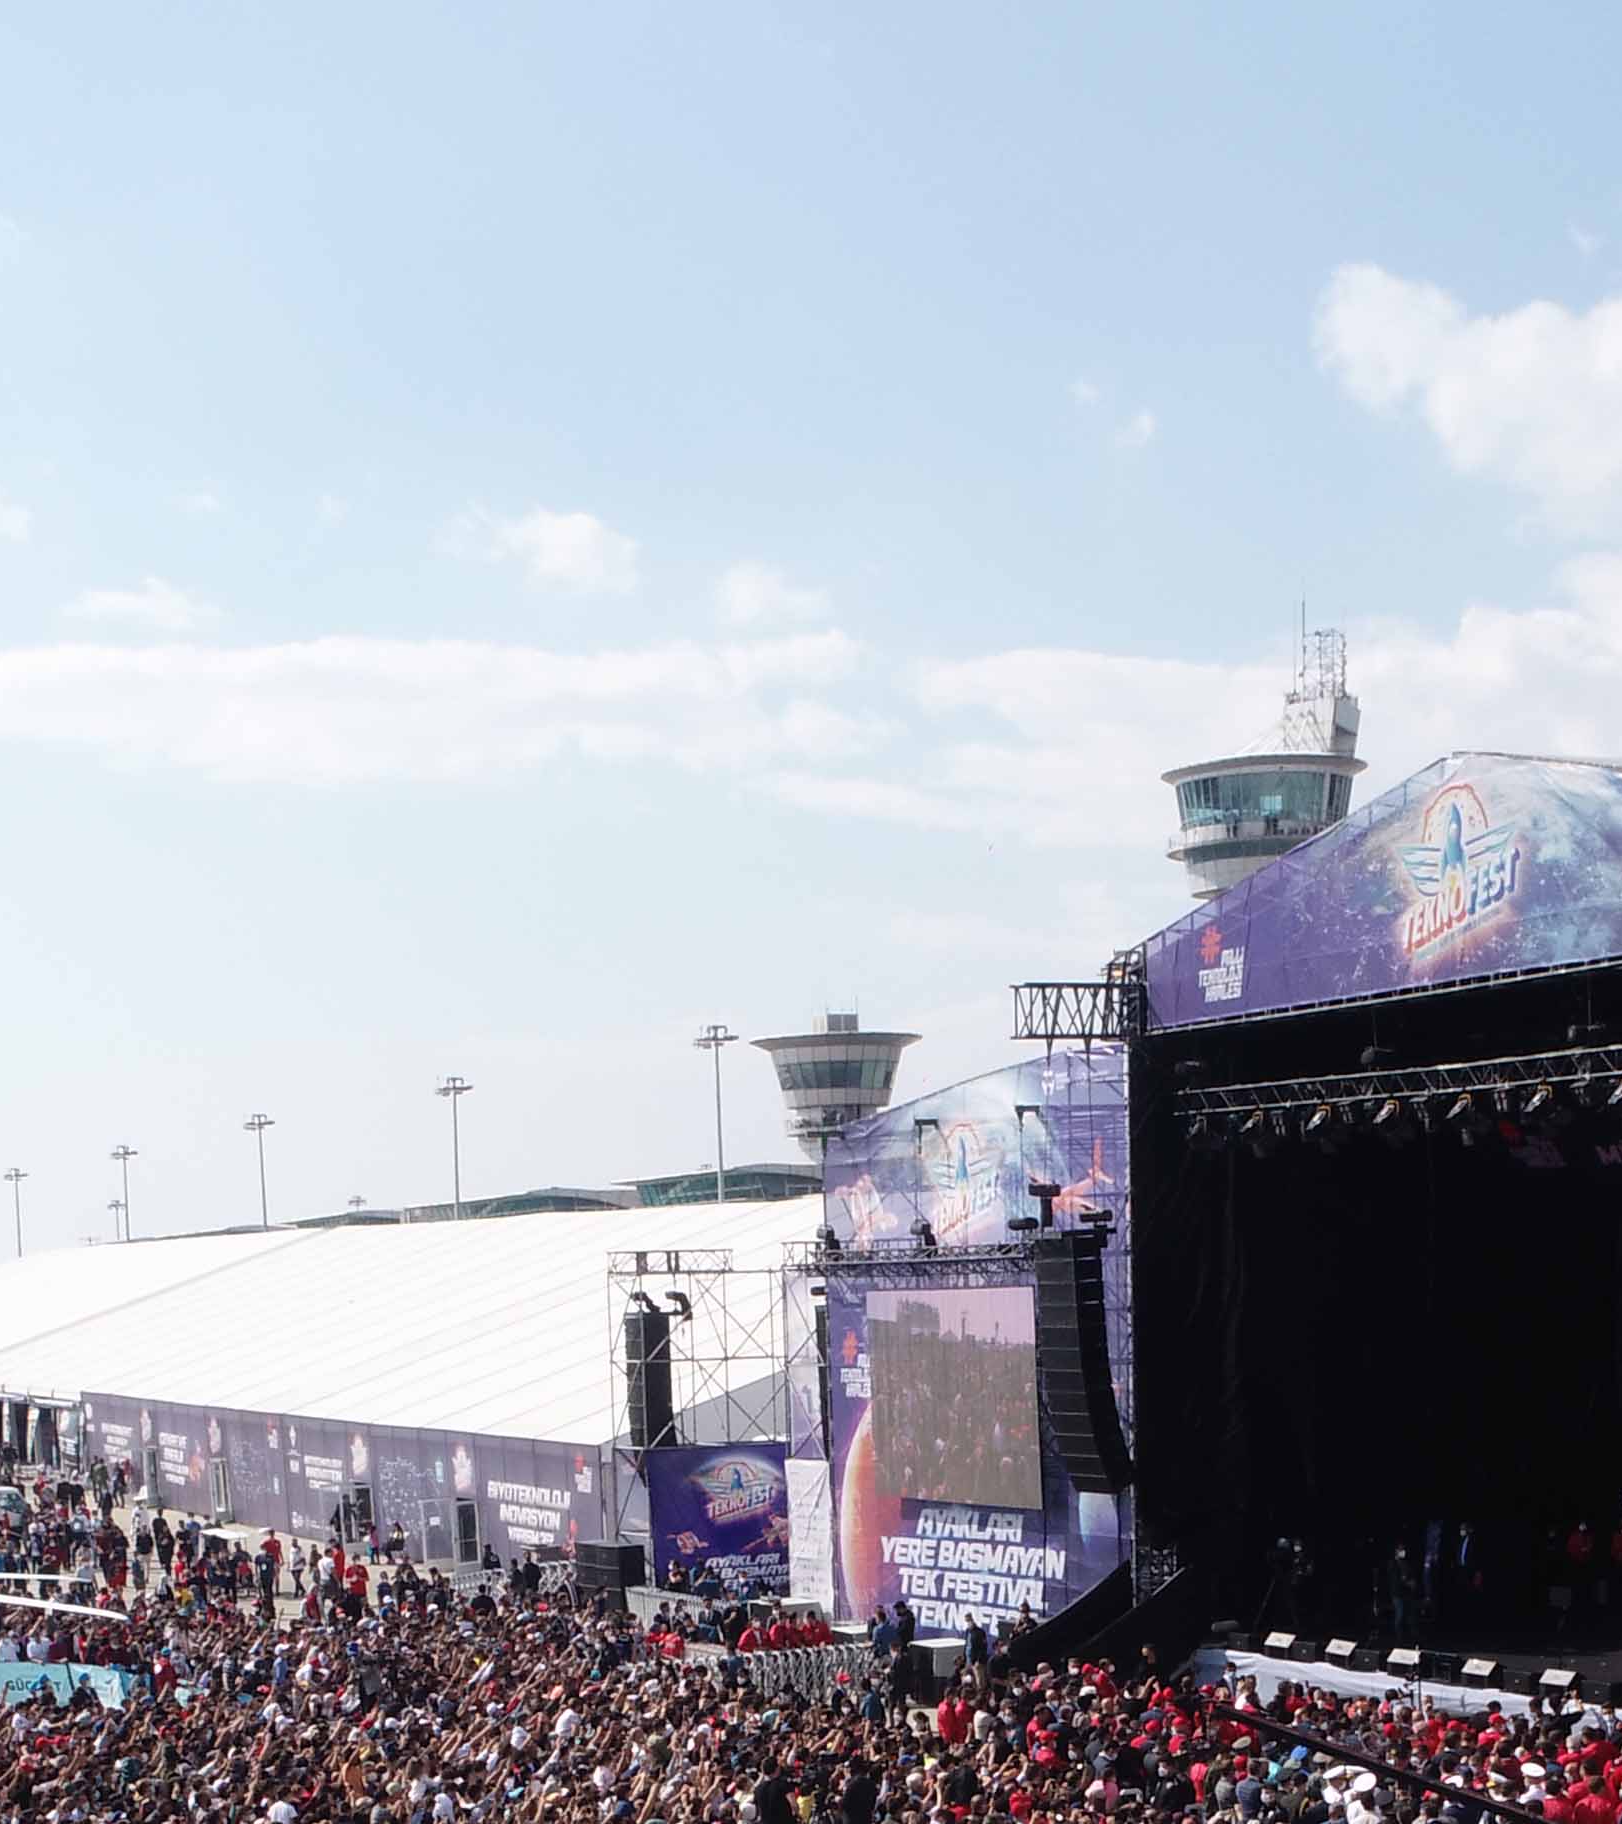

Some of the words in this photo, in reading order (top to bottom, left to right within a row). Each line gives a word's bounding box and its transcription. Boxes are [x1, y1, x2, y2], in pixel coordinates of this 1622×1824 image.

[1403, 847, 1520, 954] TEKNOFEST
[706, 1484, 774, 1521] TEKNOFEST
[916, 1507, 1025, 1544] AYAKLARI
[881, 1536, 937, 1567] YERE
[938, 1540, 1066, 1580] BASMAYAN
[899, 1568, 940, 1597] TEK
